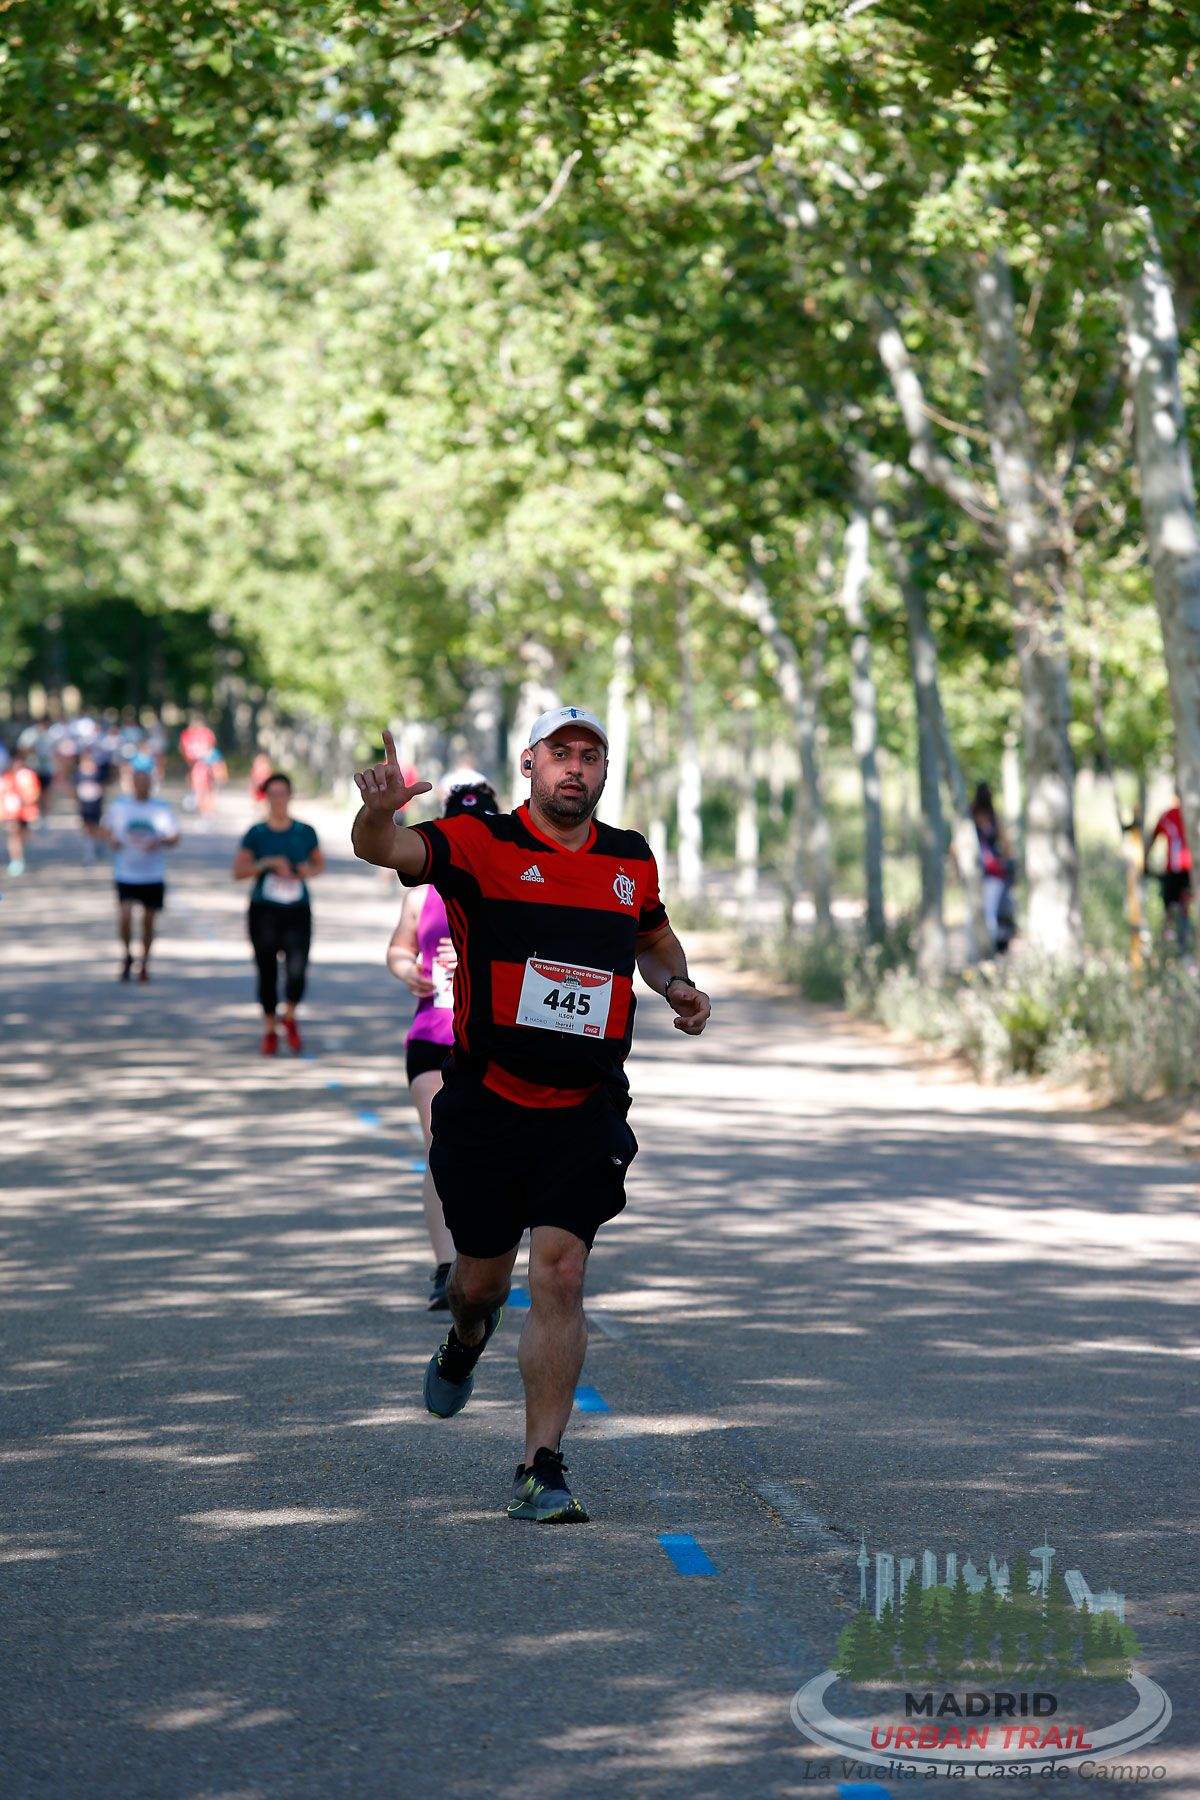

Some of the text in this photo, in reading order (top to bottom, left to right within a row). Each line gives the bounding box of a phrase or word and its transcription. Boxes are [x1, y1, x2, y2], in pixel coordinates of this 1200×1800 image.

[520, 874, 545, 883] adidas
[542, 964, 560, 973] Vuelta
[543, 988, 591, 1016] 445
